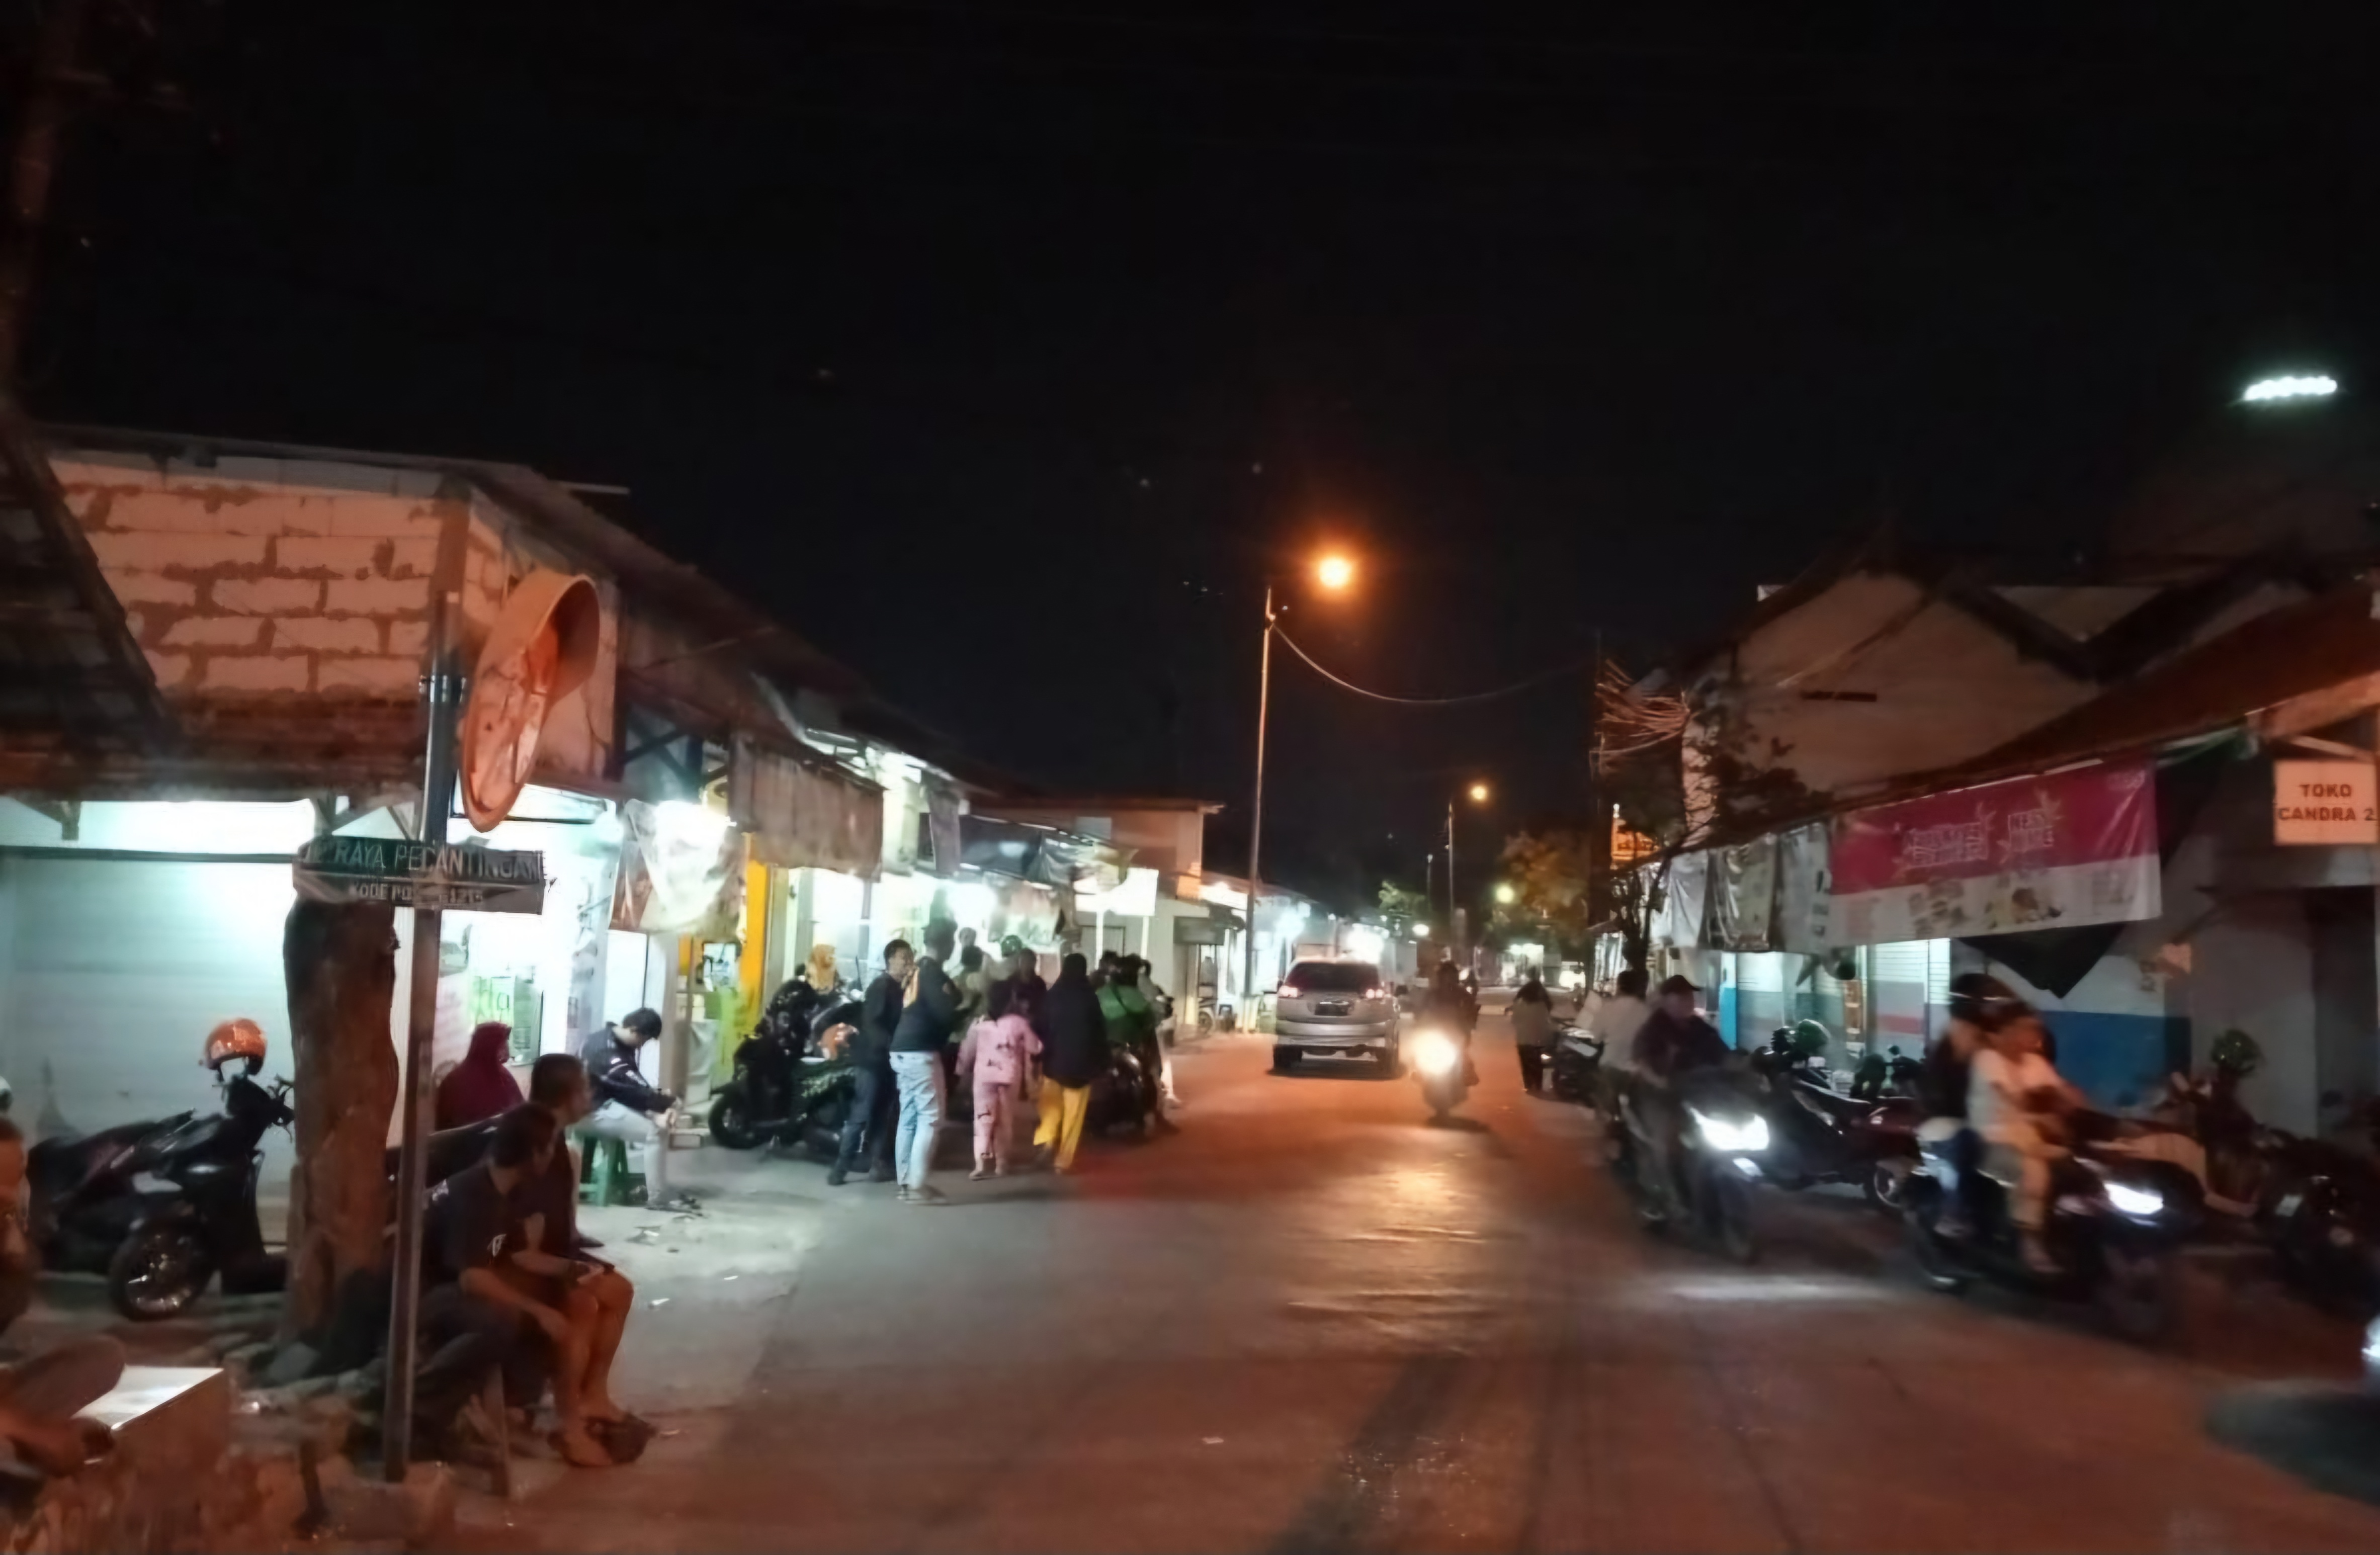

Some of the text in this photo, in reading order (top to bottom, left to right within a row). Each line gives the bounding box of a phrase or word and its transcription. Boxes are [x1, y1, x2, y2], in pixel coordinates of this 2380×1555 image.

[2299, 784, 2352, 798] TOKO
[2278, 807, 2377, 821] CANDRA 2
[333, 840, 386, 871] RAYA
